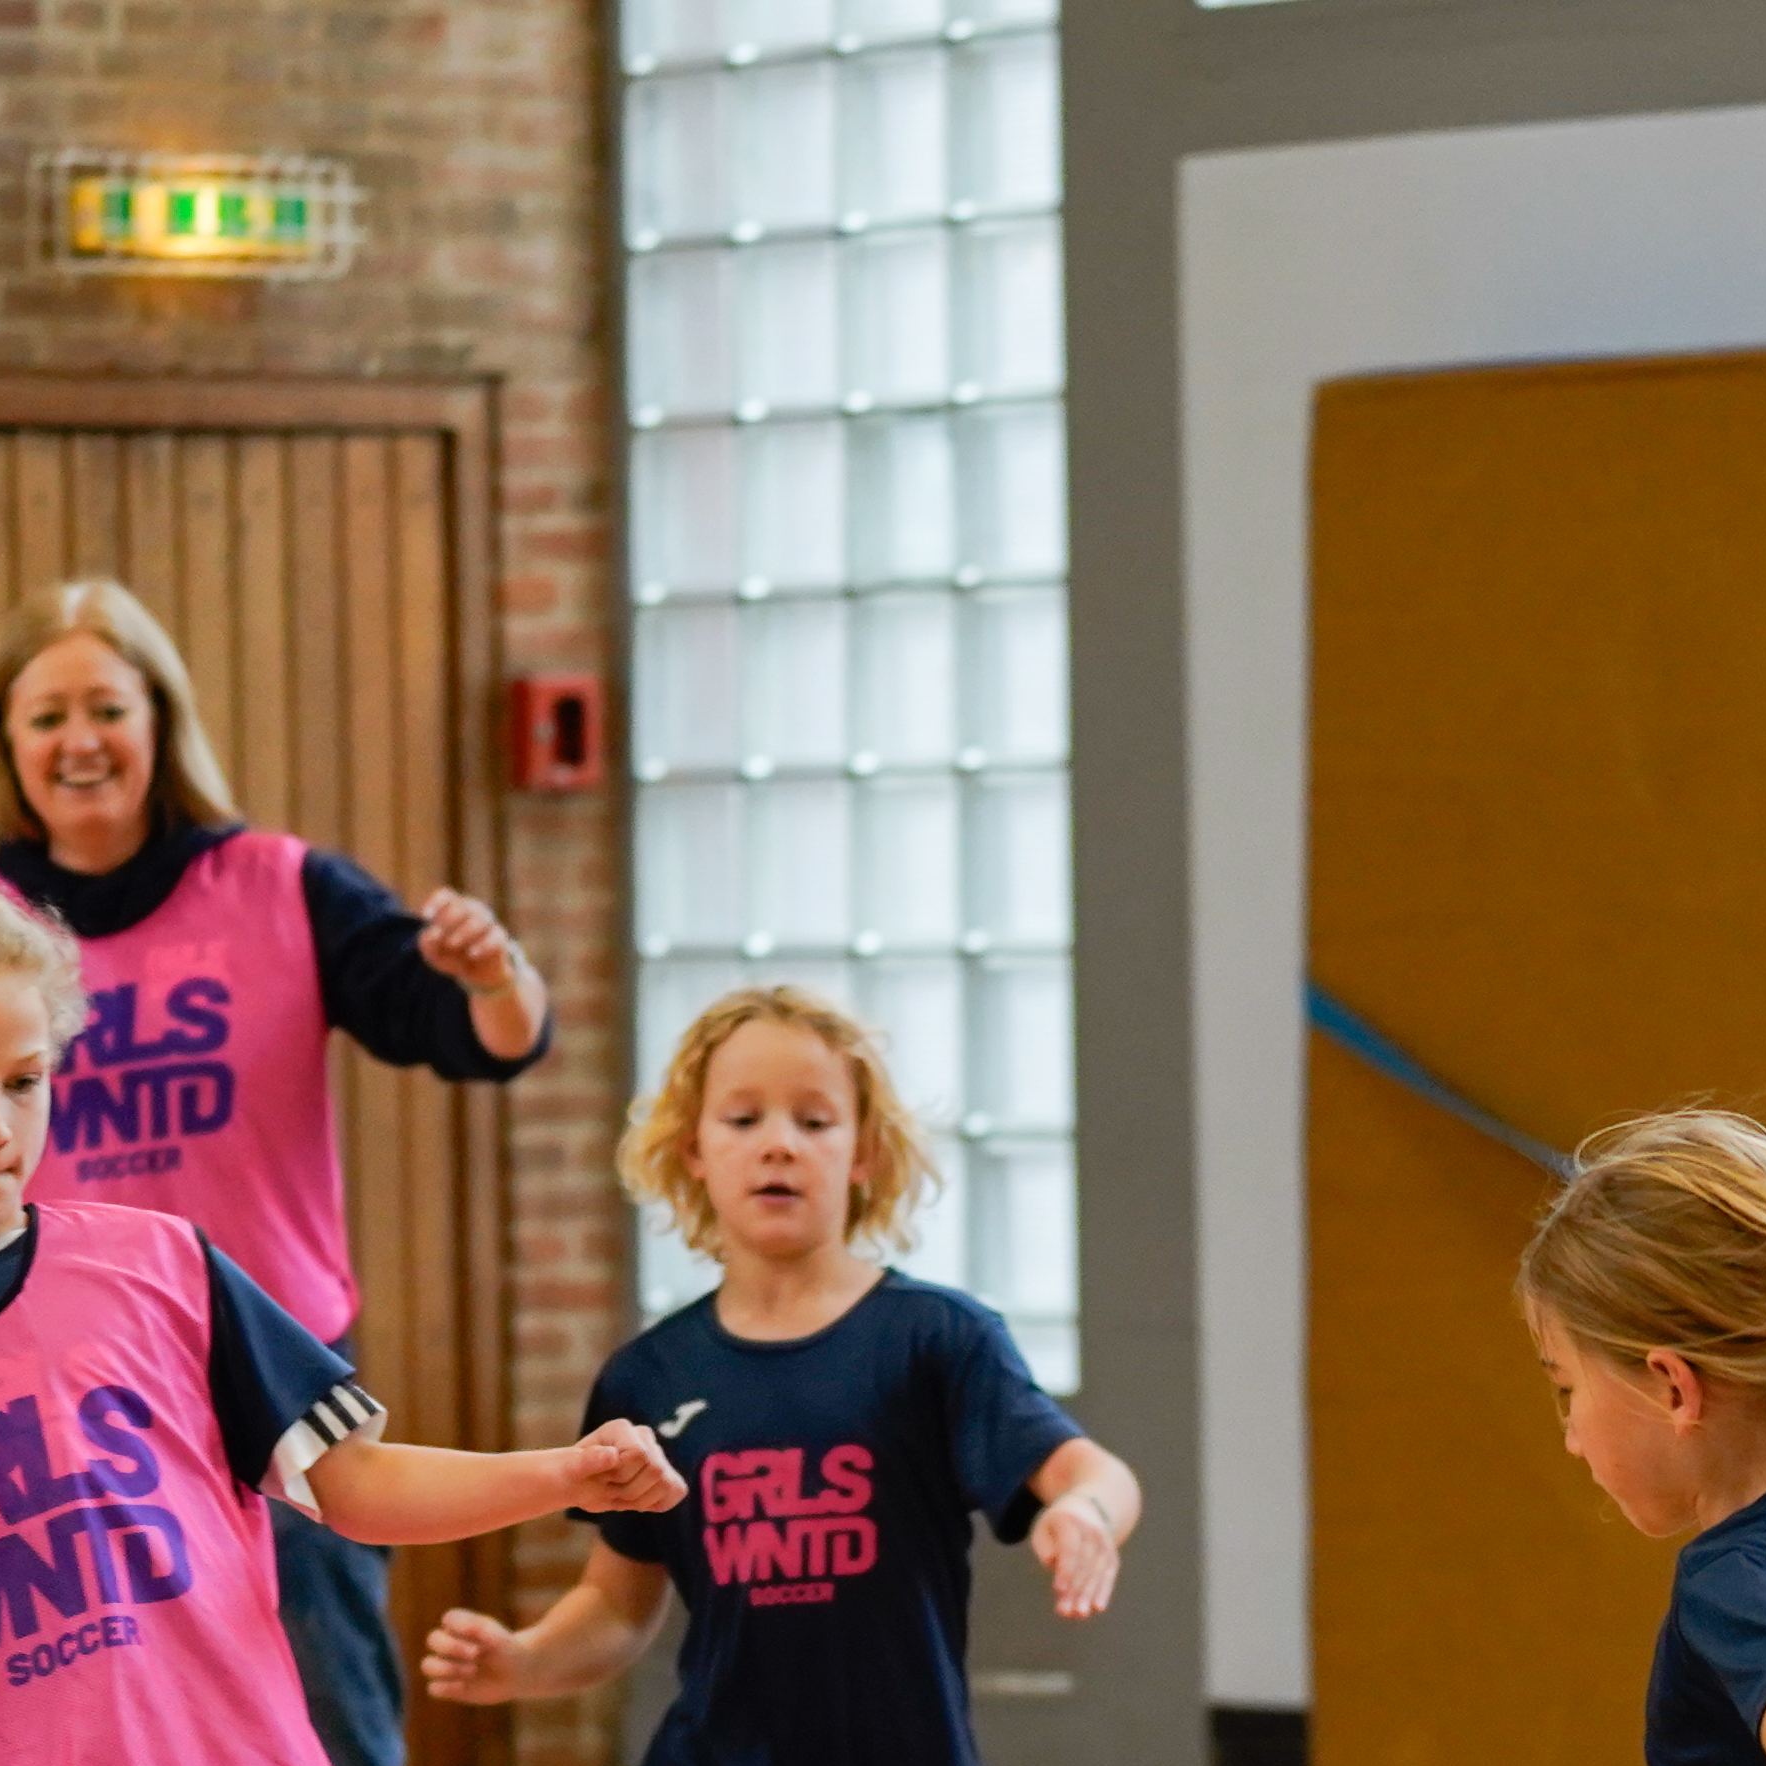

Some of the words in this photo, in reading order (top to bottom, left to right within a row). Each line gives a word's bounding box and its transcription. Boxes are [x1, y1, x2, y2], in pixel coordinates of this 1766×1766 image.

[699, 1444, 875, 1524] GRLS
[702, 1516, 878, 1586] WNTD
[749, 1582, 835, 1606] SOCCER
[5, 1614, 142, 1687] SOCCER
